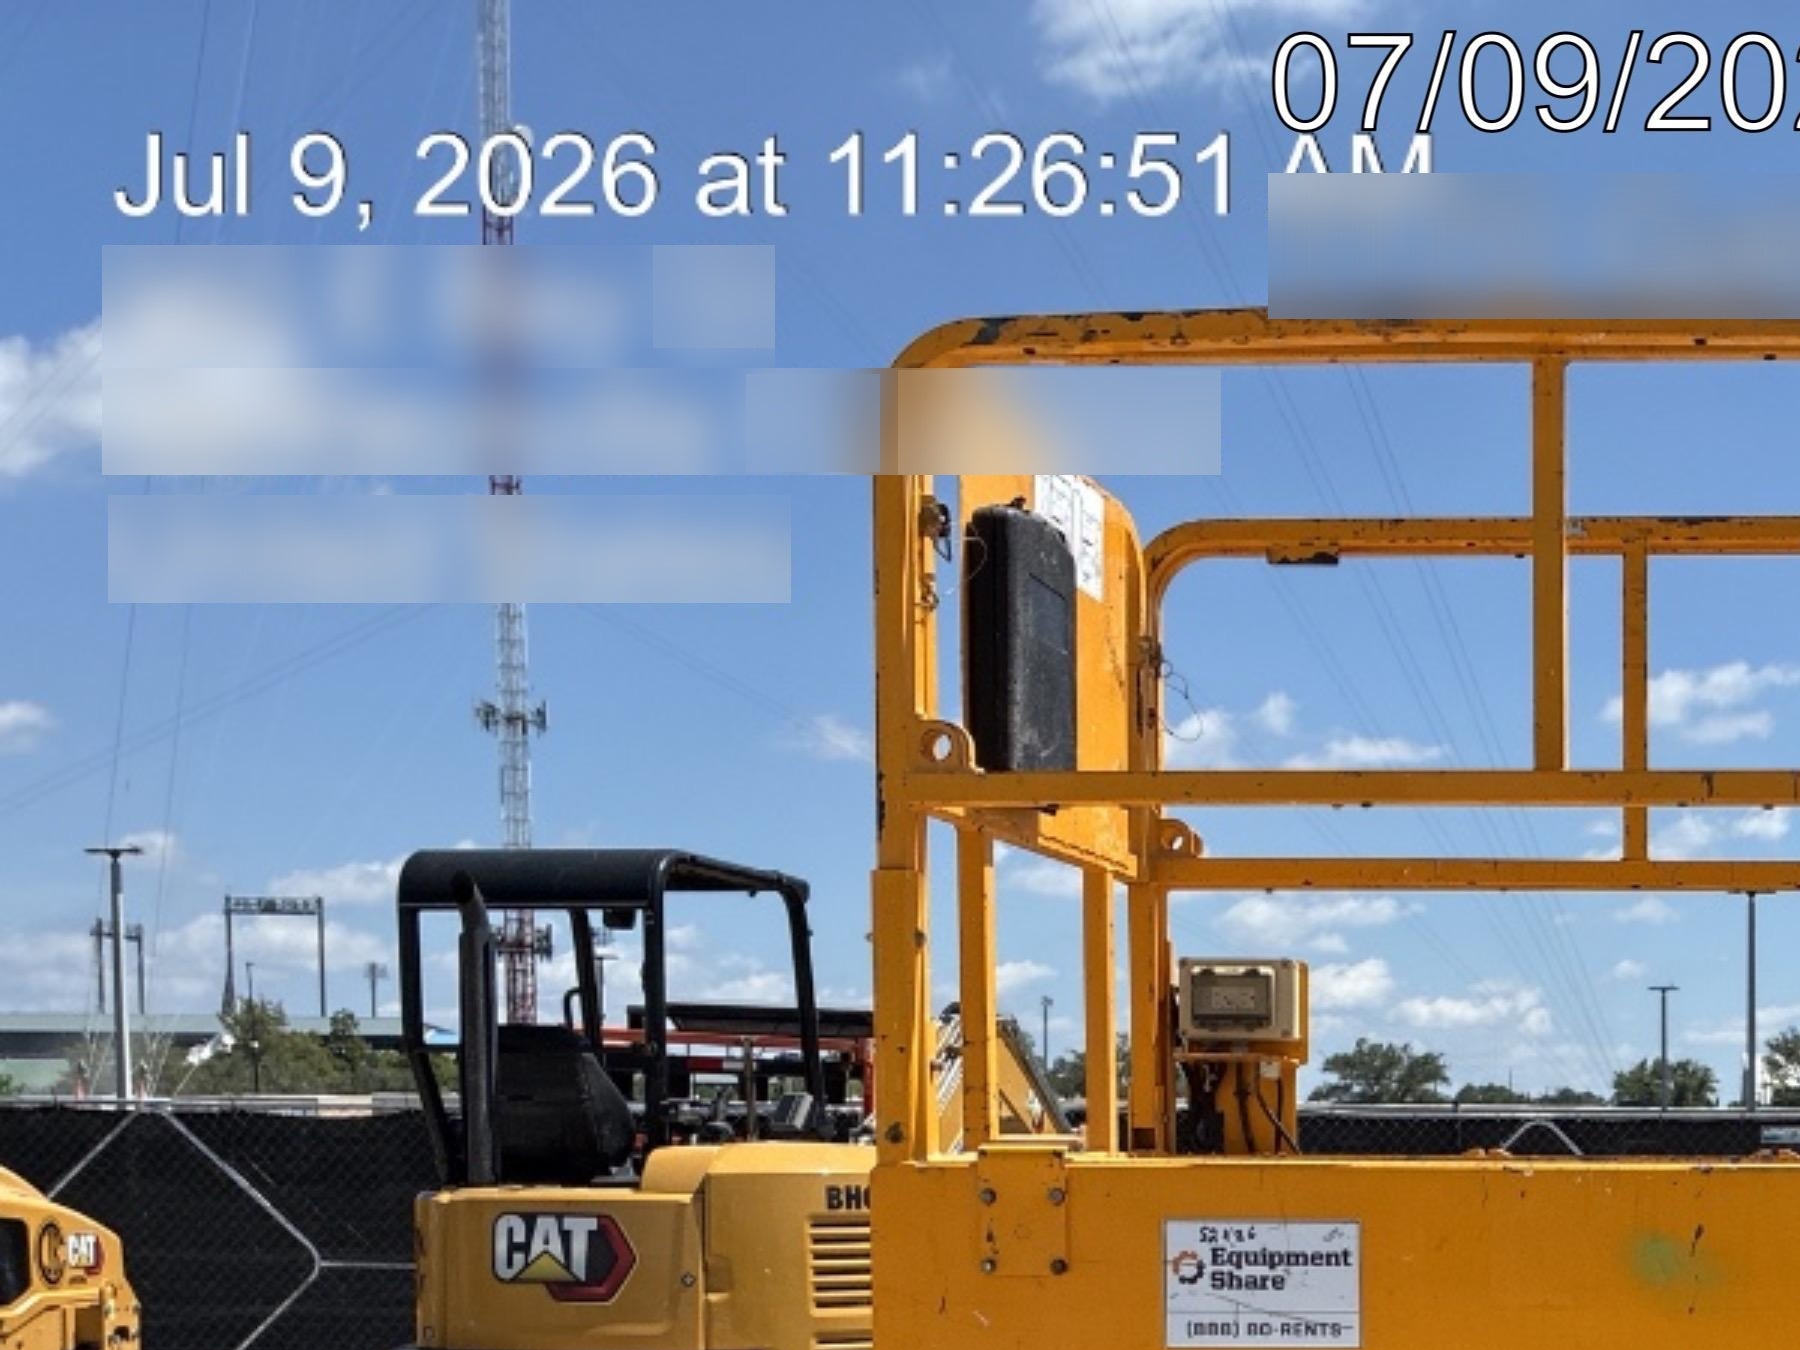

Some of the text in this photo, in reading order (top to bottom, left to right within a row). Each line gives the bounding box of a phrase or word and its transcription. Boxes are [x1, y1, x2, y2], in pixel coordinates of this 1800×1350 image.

[67, 1234, 97, 1268] CAT
[493, 1213, 599, 1282] CAT
[1210, 1247, 1354, 1270] Equipment
[1210, 1270, 1286, 1291] Share
